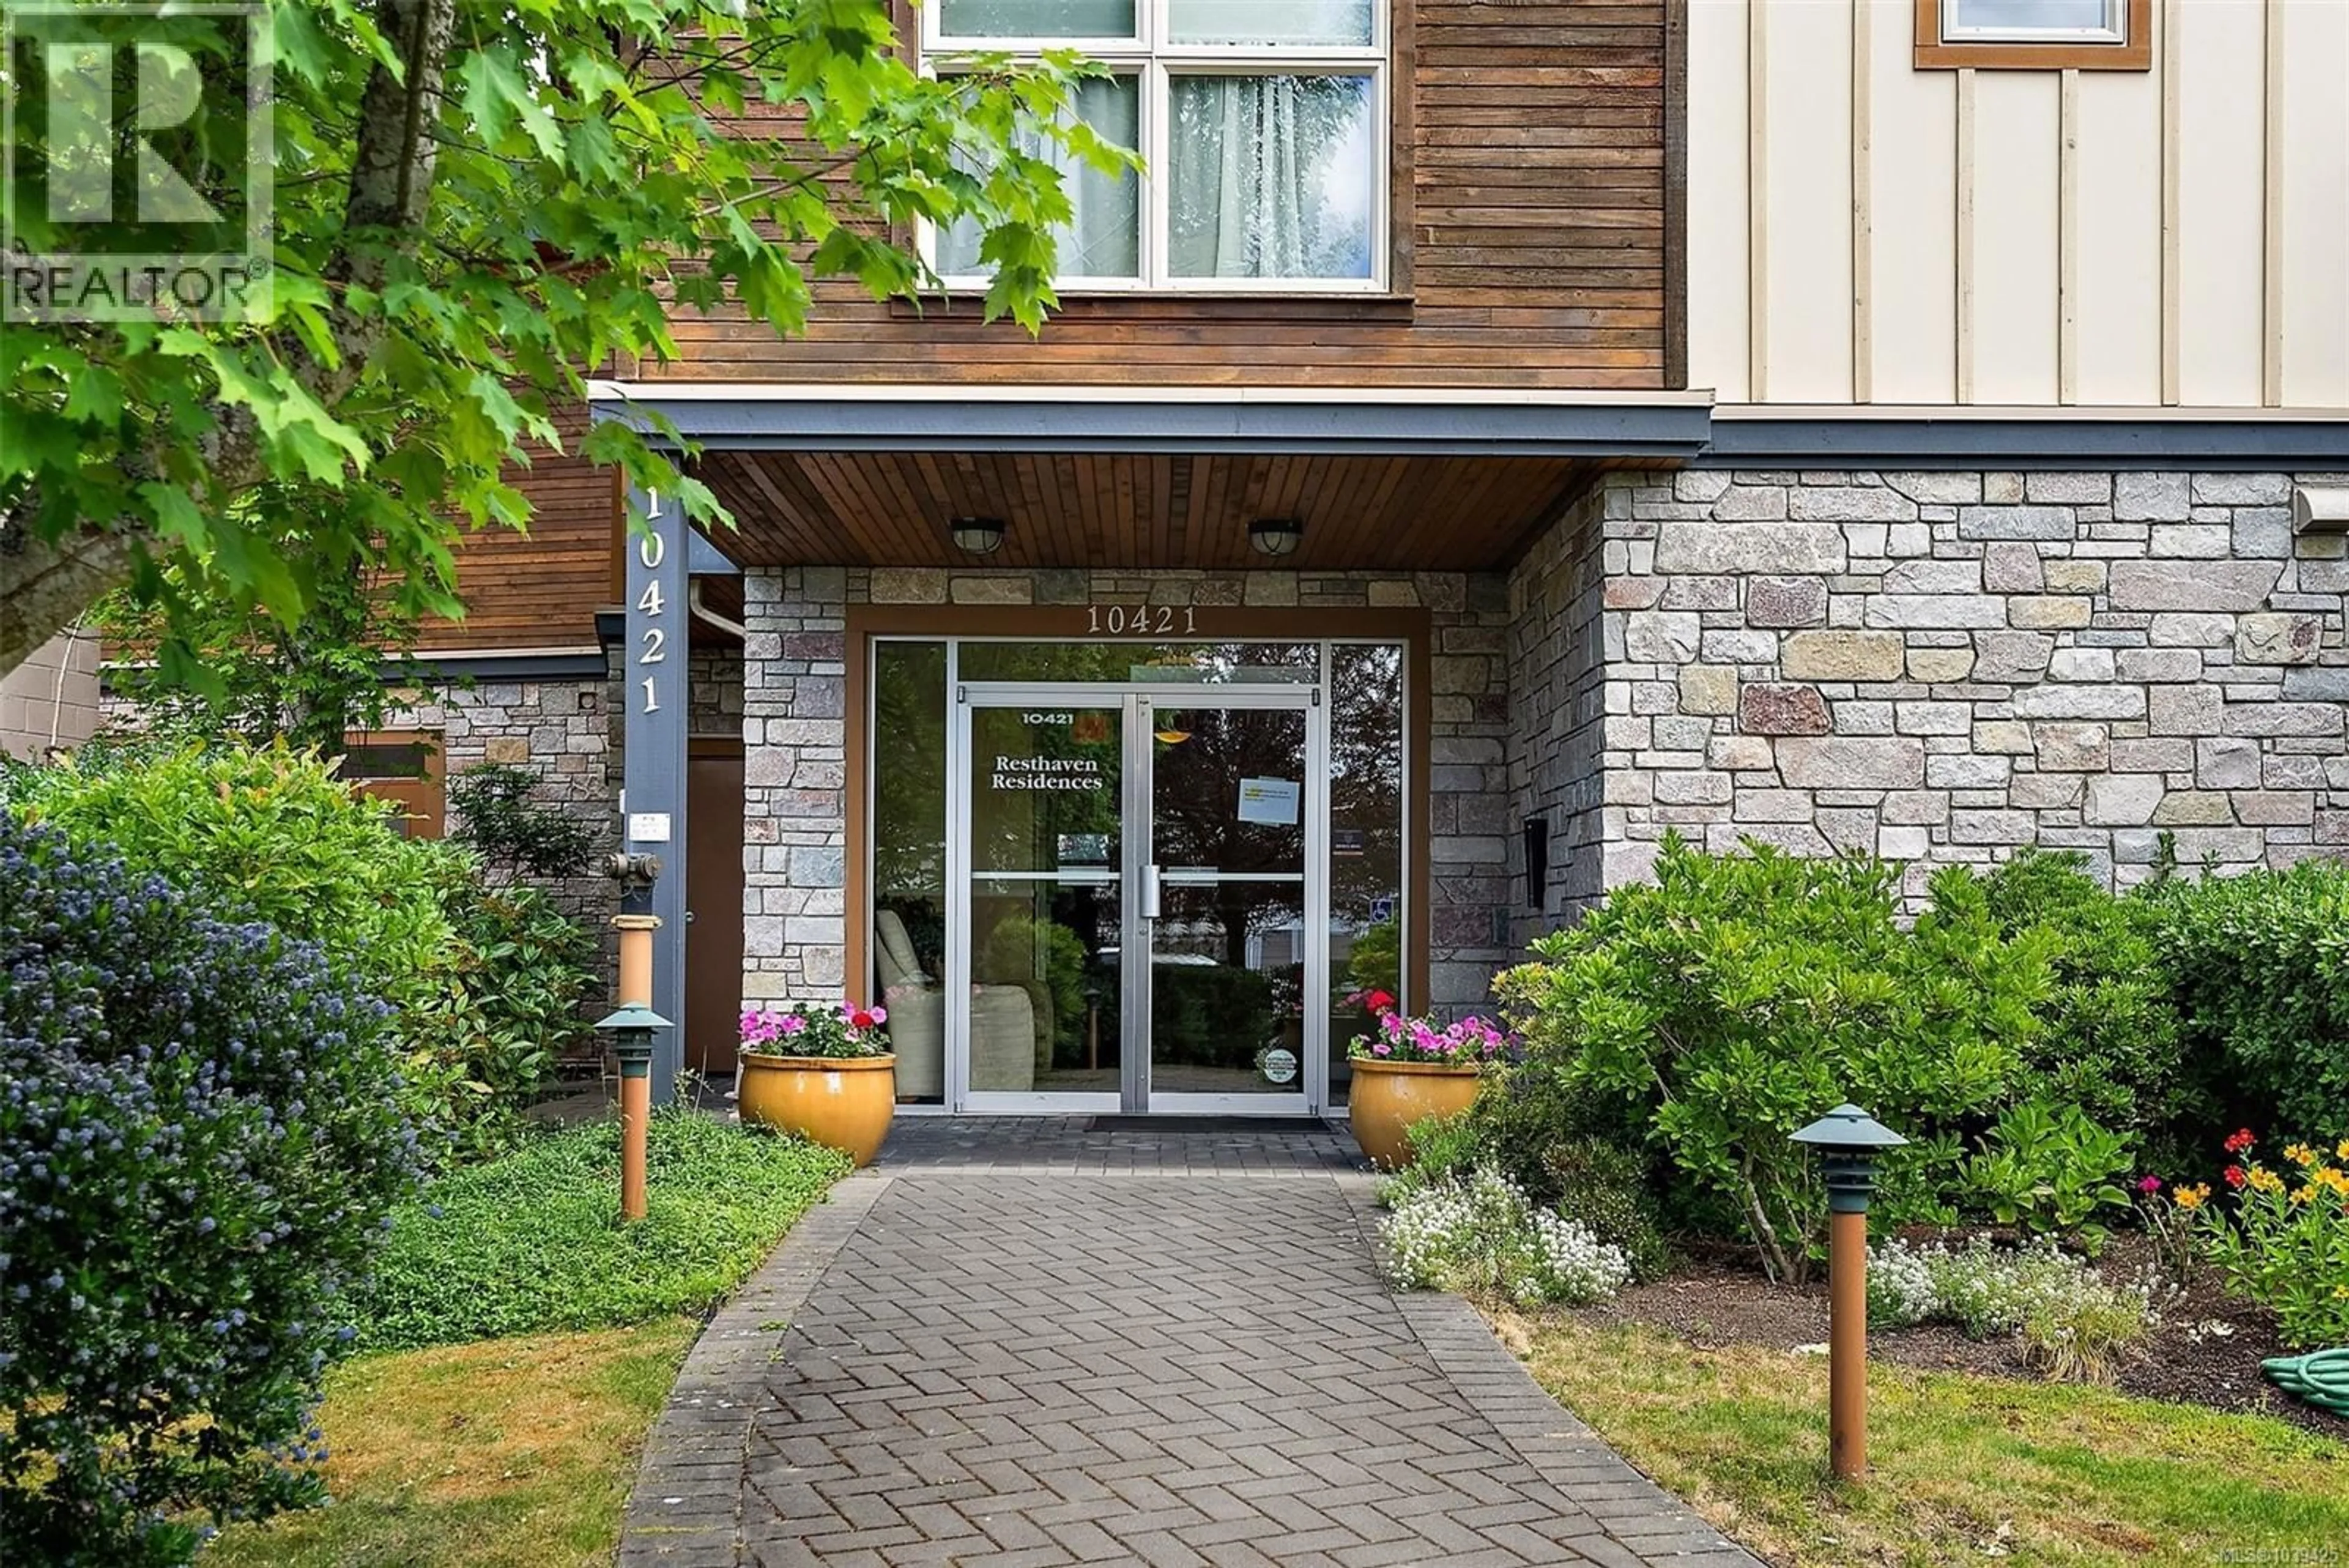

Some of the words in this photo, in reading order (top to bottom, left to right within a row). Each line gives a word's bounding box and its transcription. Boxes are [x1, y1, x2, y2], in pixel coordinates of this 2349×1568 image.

[637, 486, 666, 714] 10421
[1088, 604, 1197, 634] 10421
[1022, 713, 1075, 725] 10421
[995, 756, 1098, 771] Resthaven
[992, 773, 1103, 790] Residences
